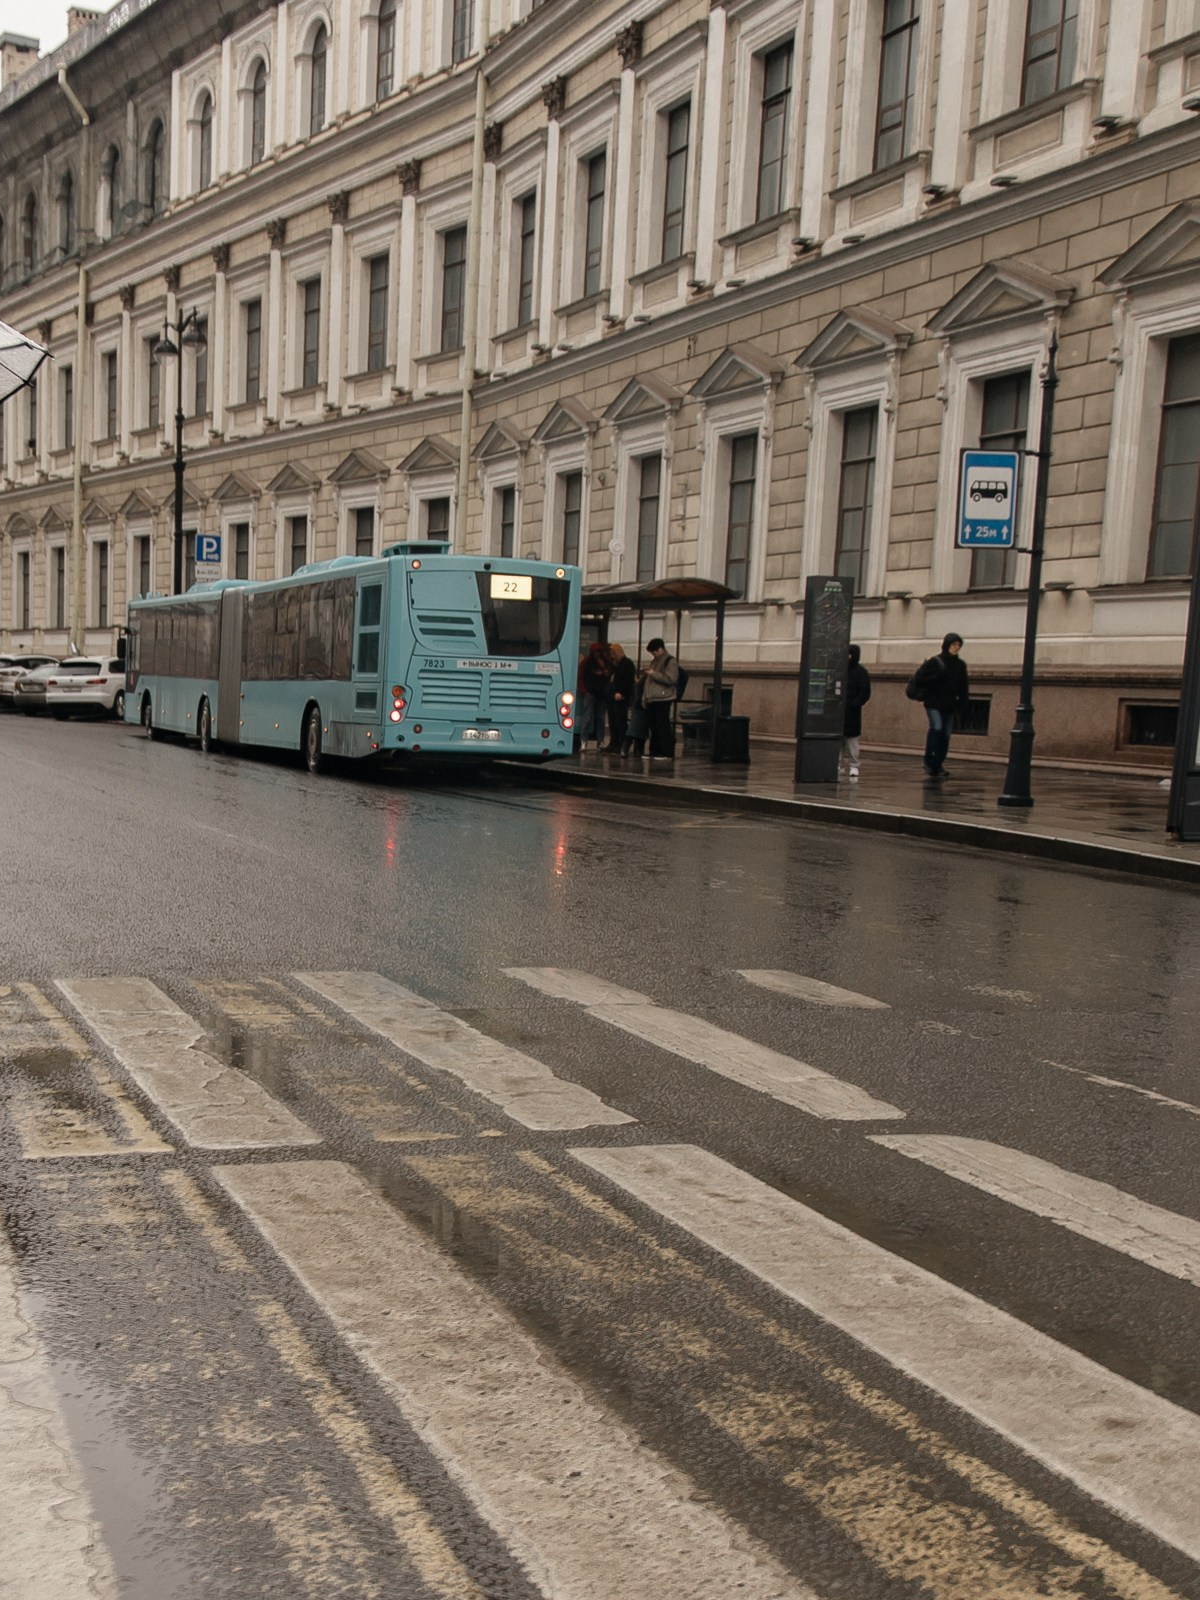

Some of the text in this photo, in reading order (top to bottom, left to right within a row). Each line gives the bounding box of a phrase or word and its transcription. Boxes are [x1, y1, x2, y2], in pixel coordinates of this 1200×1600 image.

[202, 537, 218, 560] P
[503, 582, 518, 593] 22
[423, 659, 445, 668] 7823
